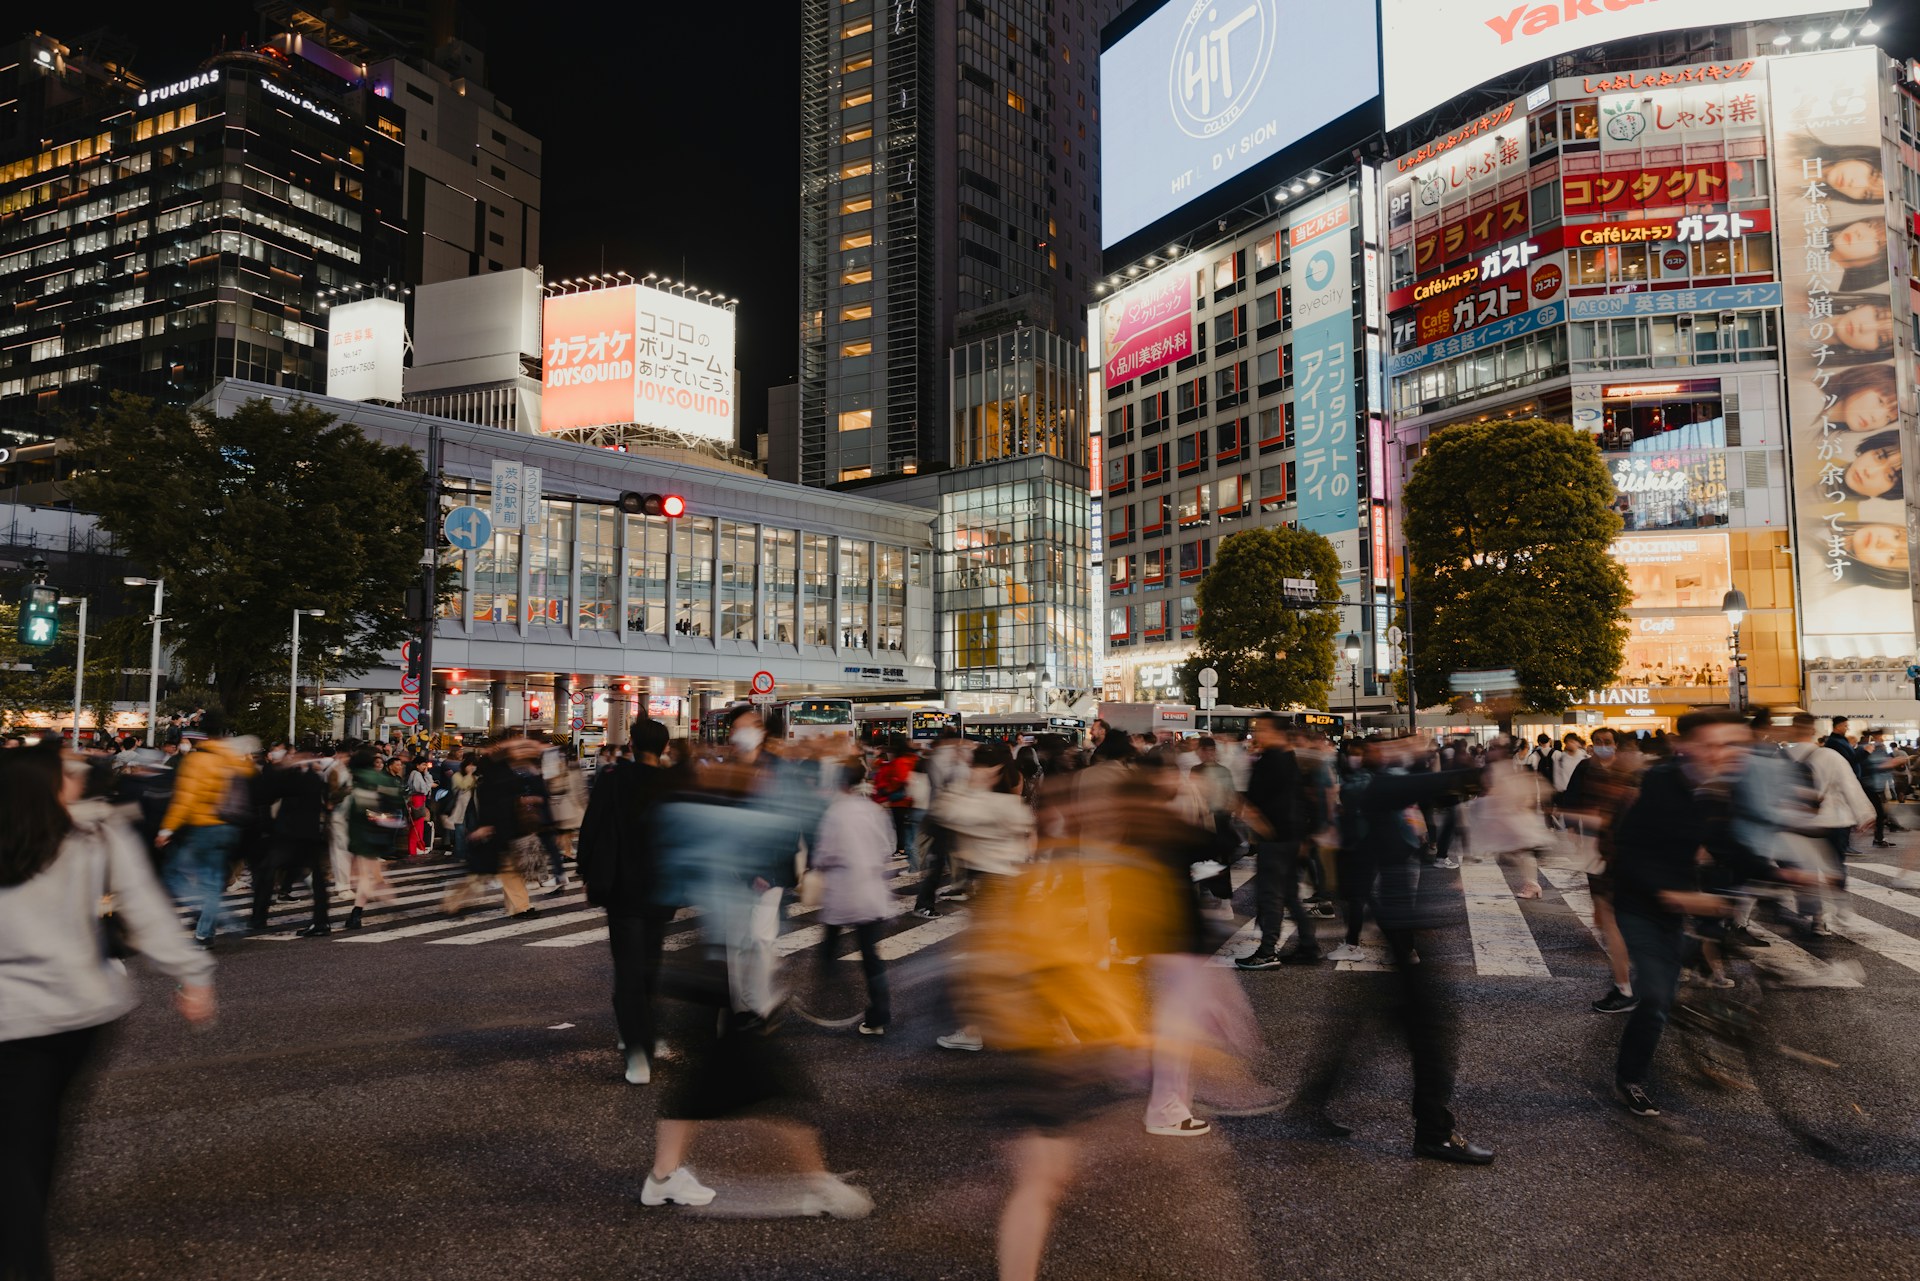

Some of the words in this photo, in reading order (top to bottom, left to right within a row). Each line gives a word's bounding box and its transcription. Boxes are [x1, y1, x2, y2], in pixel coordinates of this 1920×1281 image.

[150, 69, 220, 103] FUKURAS
[1583, 60, 1756, 94] しゃぶしゃぶバイキング
[260, 79, 301, 105] TOKYU
[301, 100, 341, 125] PLAZA
[1655, 93, 1758, 131] しゃぶ葉
[1397, 101, 1516, 172] しゃぶしゃぶバイキング
[1451, 136, 1520, 188] しゃぶ葉
[1391, 192, 1410, 216] 9F
[1565, 168, 1725, 206] コンタクト
[1295, 207, 1343, 243] 当ビル5F
[1417, 199, 1527, 265] プライス
[1677, 212, 1755, 243] ガスト
[1481, 241, 1539, 282] ガスト
[1298, 288, 1344, 316] eyecity
[1535, 277, 1560, 293] ガスト
[1576, 298, 1623, 315] AEON
[1634, 288, 1777, 312] 英会話イーオン
[1141, 295, 1182, 325] クリニック
[1452, 284, 1522, 333] ガスト
[334, 327, 374, 347] 広告募集
[640, 311, 711, 348] ココロの
[1392, 350, 1422, 371] AEON
[1432, 317, 1532, 361] 英会話イーオン
[1539, 308, 1556, 323] 6F
[1393, 320, 1416, 346] 7F
[548, 330, 632, 367] カラオケ
[639, 337, 730, 377] ボリューム、
[1116, 330, 1188, 377] 品川美容外科
[330, 361, 376, 378] 03-5774-7505
[546, 360, 633, 388] JOYSOUND
[639, 360, 730, 396] あげていこう。
[1800, 157, 1852, 582] 日本武道館公演のチケットが余ってます
[636, 379, 730, 418] JOYSOUND
[1300, 349, 1328, 501] アイシティ
[1328, 342, 1350, 497] コンタクトの
[495, 474, 503, 501] Shibuya
[504, 467, 518, 523] 渋谷駅前
[527, 469, 537, 523] スクランブル式
[1640, 617, 1675, 634] Café
